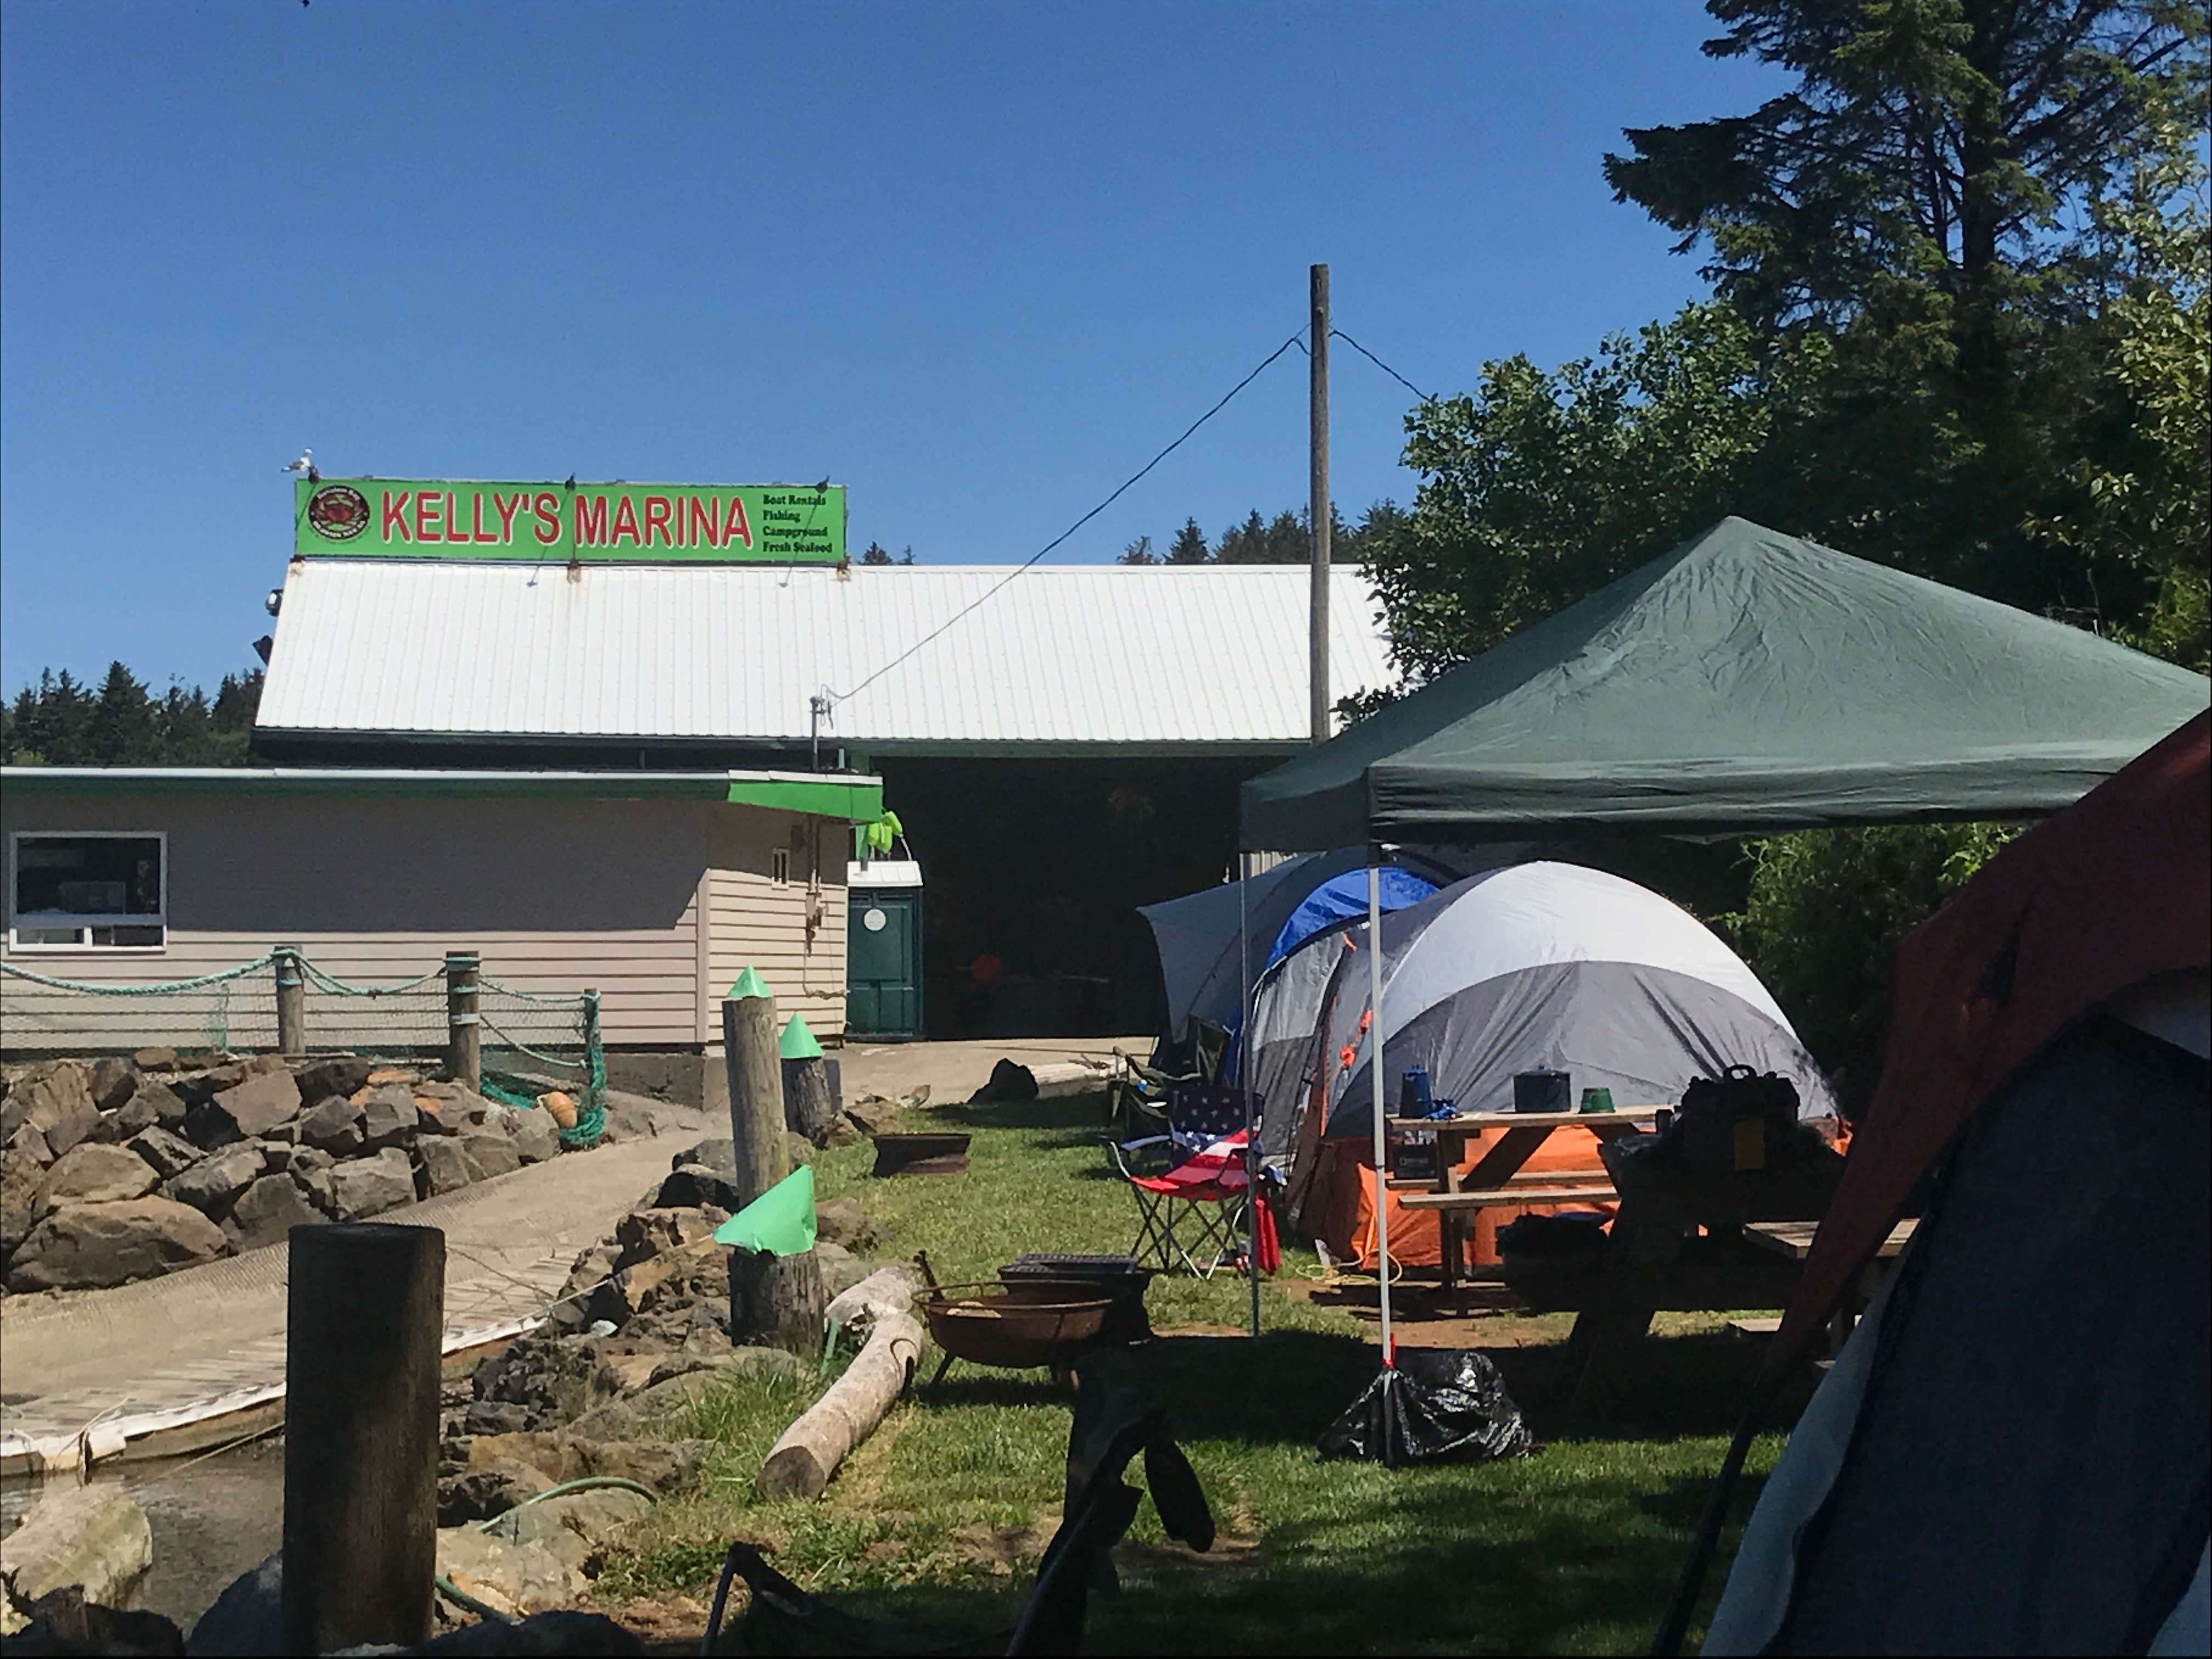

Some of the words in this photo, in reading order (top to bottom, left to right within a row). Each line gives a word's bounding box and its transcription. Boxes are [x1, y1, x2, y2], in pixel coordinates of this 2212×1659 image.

[763, 494, 786, 505] Boat
[789, 495, 826, 505] Rentals
[382, 491, 562, 546] KELLY'S
[574, 495, 753, 550] MARINA
[763, 510, 800, 523] Fishing
[763, 526, 827, 538] Campground
[763, 541, 791, 552] Fresh
[793, 541, 832, 553] Seafood
